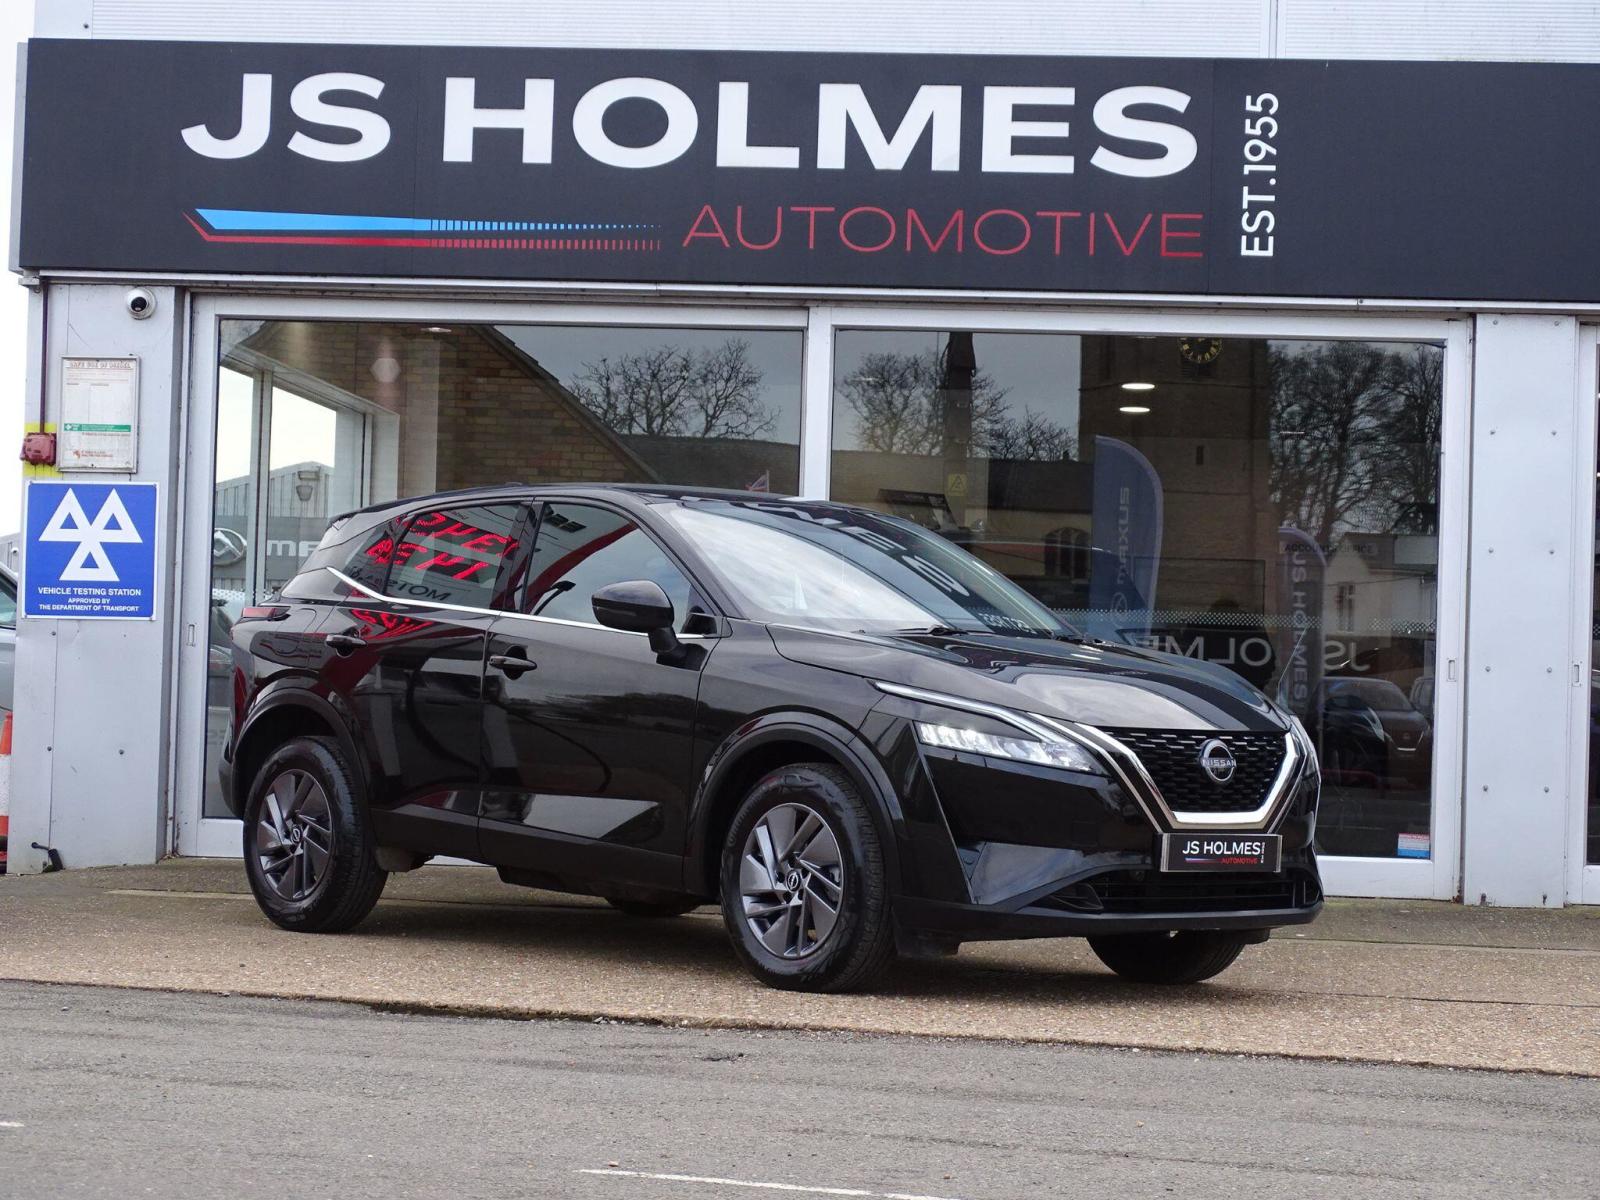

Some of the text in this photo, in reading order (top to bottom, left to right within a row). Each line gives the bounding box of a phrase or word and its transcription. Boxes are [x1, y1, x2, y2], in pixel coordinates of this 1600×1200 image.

[181, 72, 1198, 178] JS HOLMES
[682, 204, 1204, 258] AUTOMOTIVE
[38, 587, 141, 596] VEHICLE TESTING STATION
[1202, 759, 1237, 768] NISSAN
[1182, 841, 1200, 855] JS
[1203, 841, 1261, 855] HOLMES
